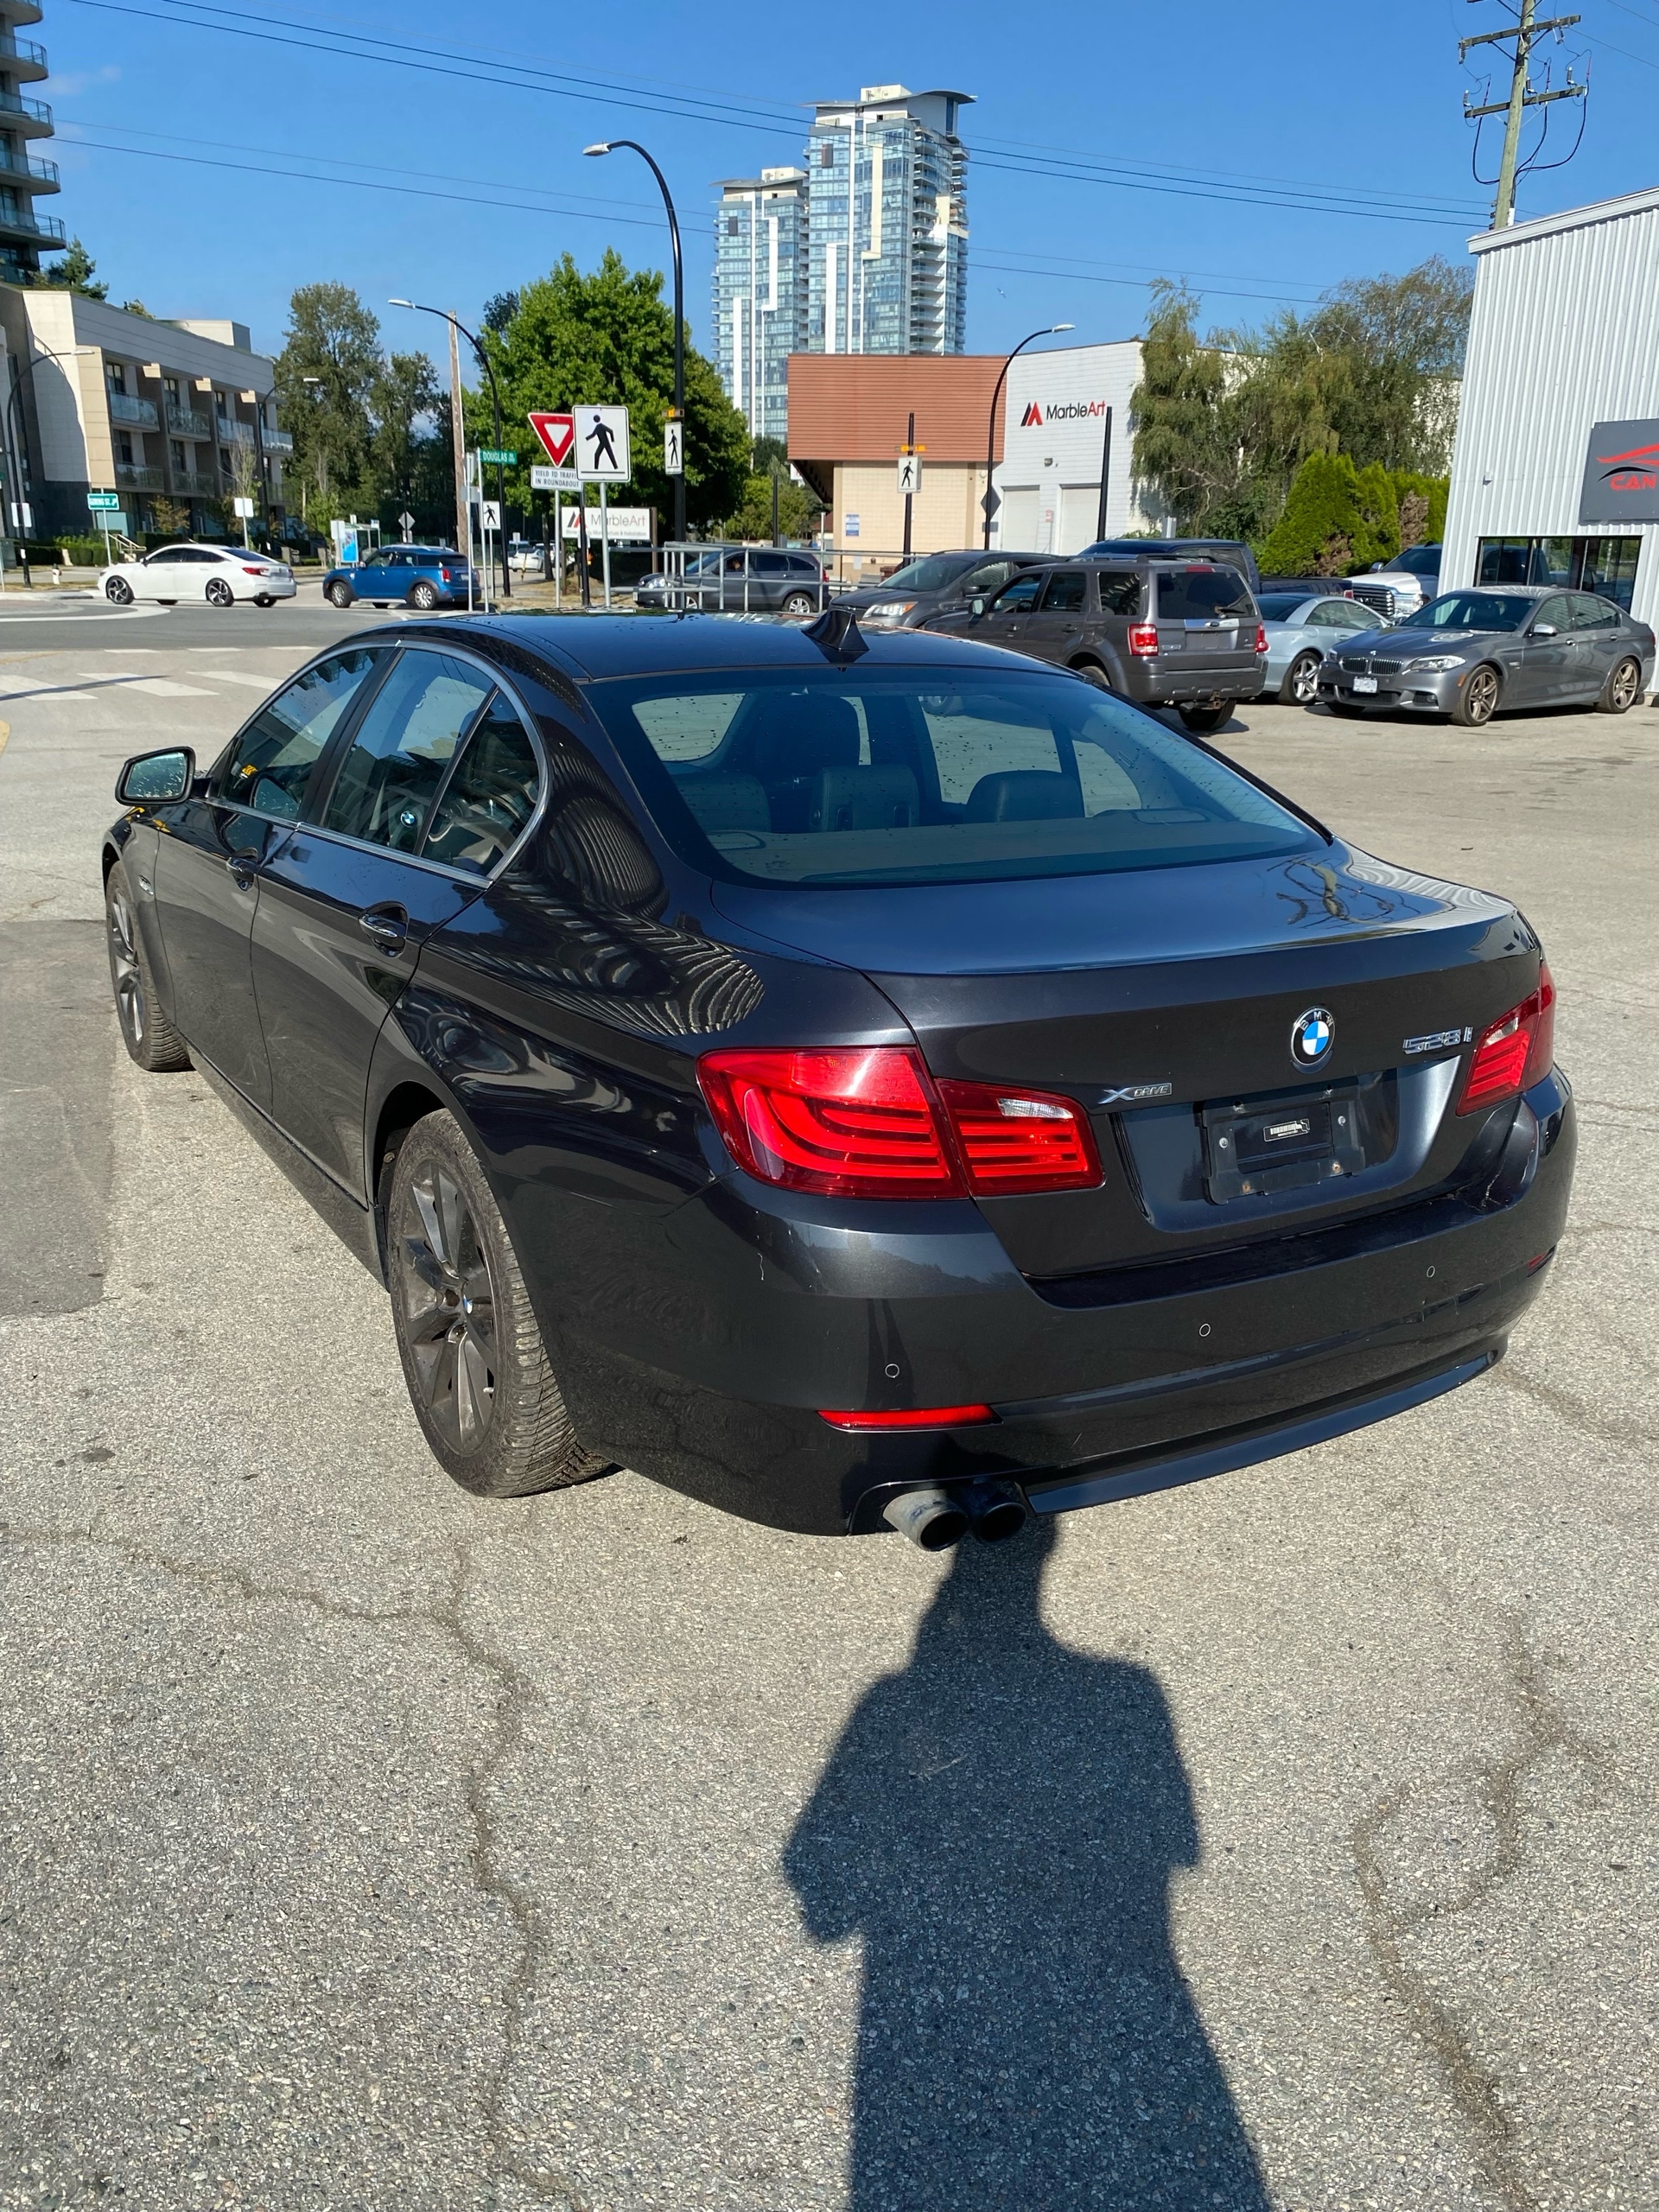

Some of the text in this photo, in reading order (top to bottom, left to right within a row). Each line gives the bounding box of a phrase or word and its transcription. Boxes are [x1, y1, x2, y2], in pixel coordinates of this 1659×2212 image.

[1046, 400, 1106, 420] MarbleArt
[482, 451, 507, 462] DOUGLAS
[543, 479, 580, 488] ROUNDABOUT
[1610, 474, 1657, 491] CAN
[1300, 1011, 1334, 1031] BMW
